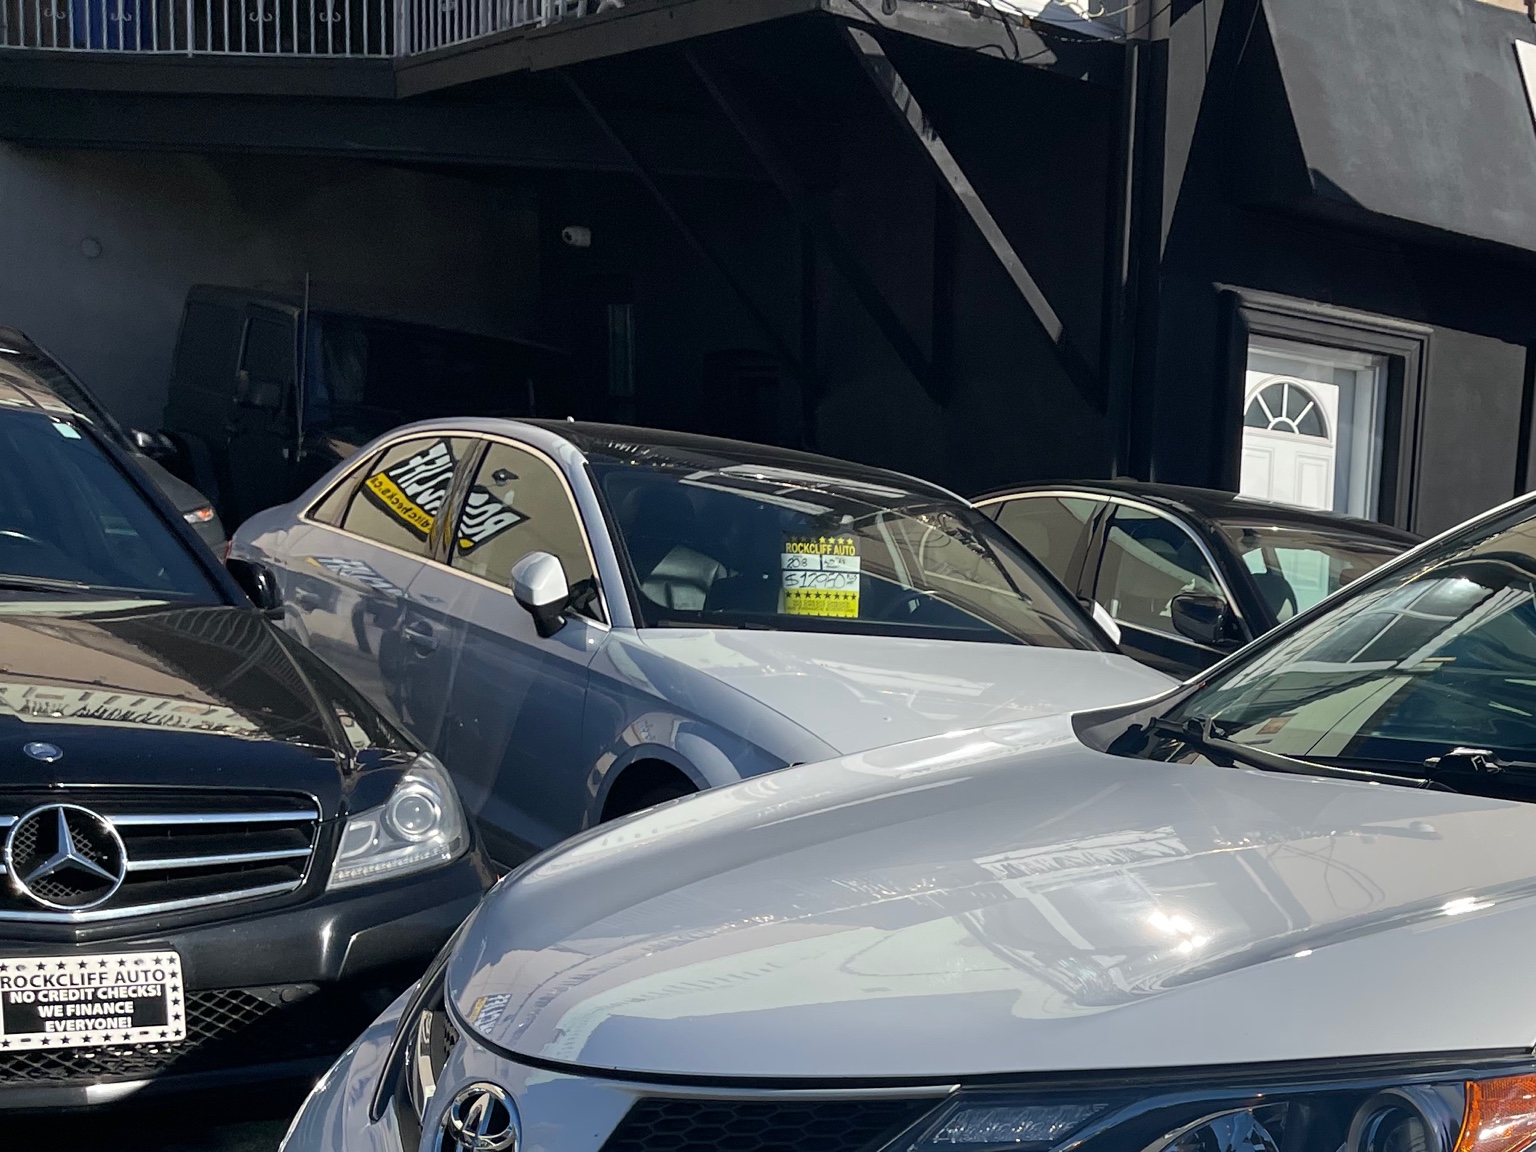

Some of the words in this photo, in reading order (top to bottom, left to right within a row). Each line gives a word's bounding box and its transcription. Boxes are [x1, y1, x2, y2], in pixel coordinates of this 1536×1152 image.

[785, 542, 833, 555] ROCKCLIFF
[834, 545, 856, 557] AUTO
[0, 972, 109, 989] ROCKCLIFF
[114, 969, 166, 984] AUTO
[10, 990, 36, 1004] NO
[38, 988, 95, 1003] CREDIT
[97, 984, 162, 999] CHECKS!
[38, 1005, 64, 1018] WE
[66, 1001, 134, 1016] FINANCE
[45, 1017, 133, 1033] EVERYONE!
